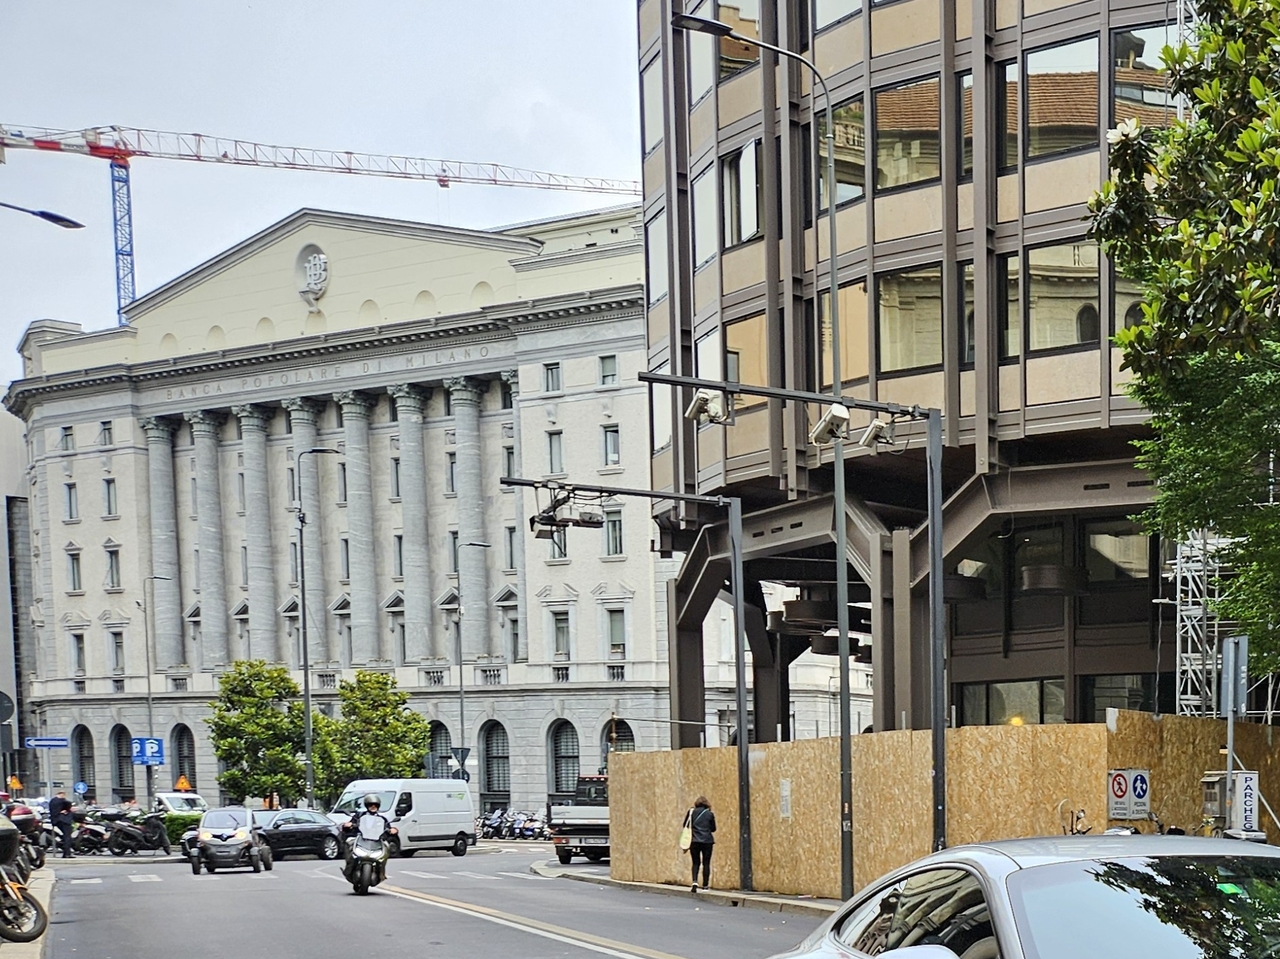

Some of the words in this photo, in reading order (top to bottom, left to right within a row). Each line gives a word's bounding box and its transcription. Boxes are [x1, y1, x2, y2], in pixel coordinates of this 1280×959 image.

[166, 384, 223, 400] BANCA
[241, 366, 341, 389] POPOLARE
[362, 361, 382, 374] DI
[405, 346, 489, 367] MILANO
[145, 744, 159, 756] P
